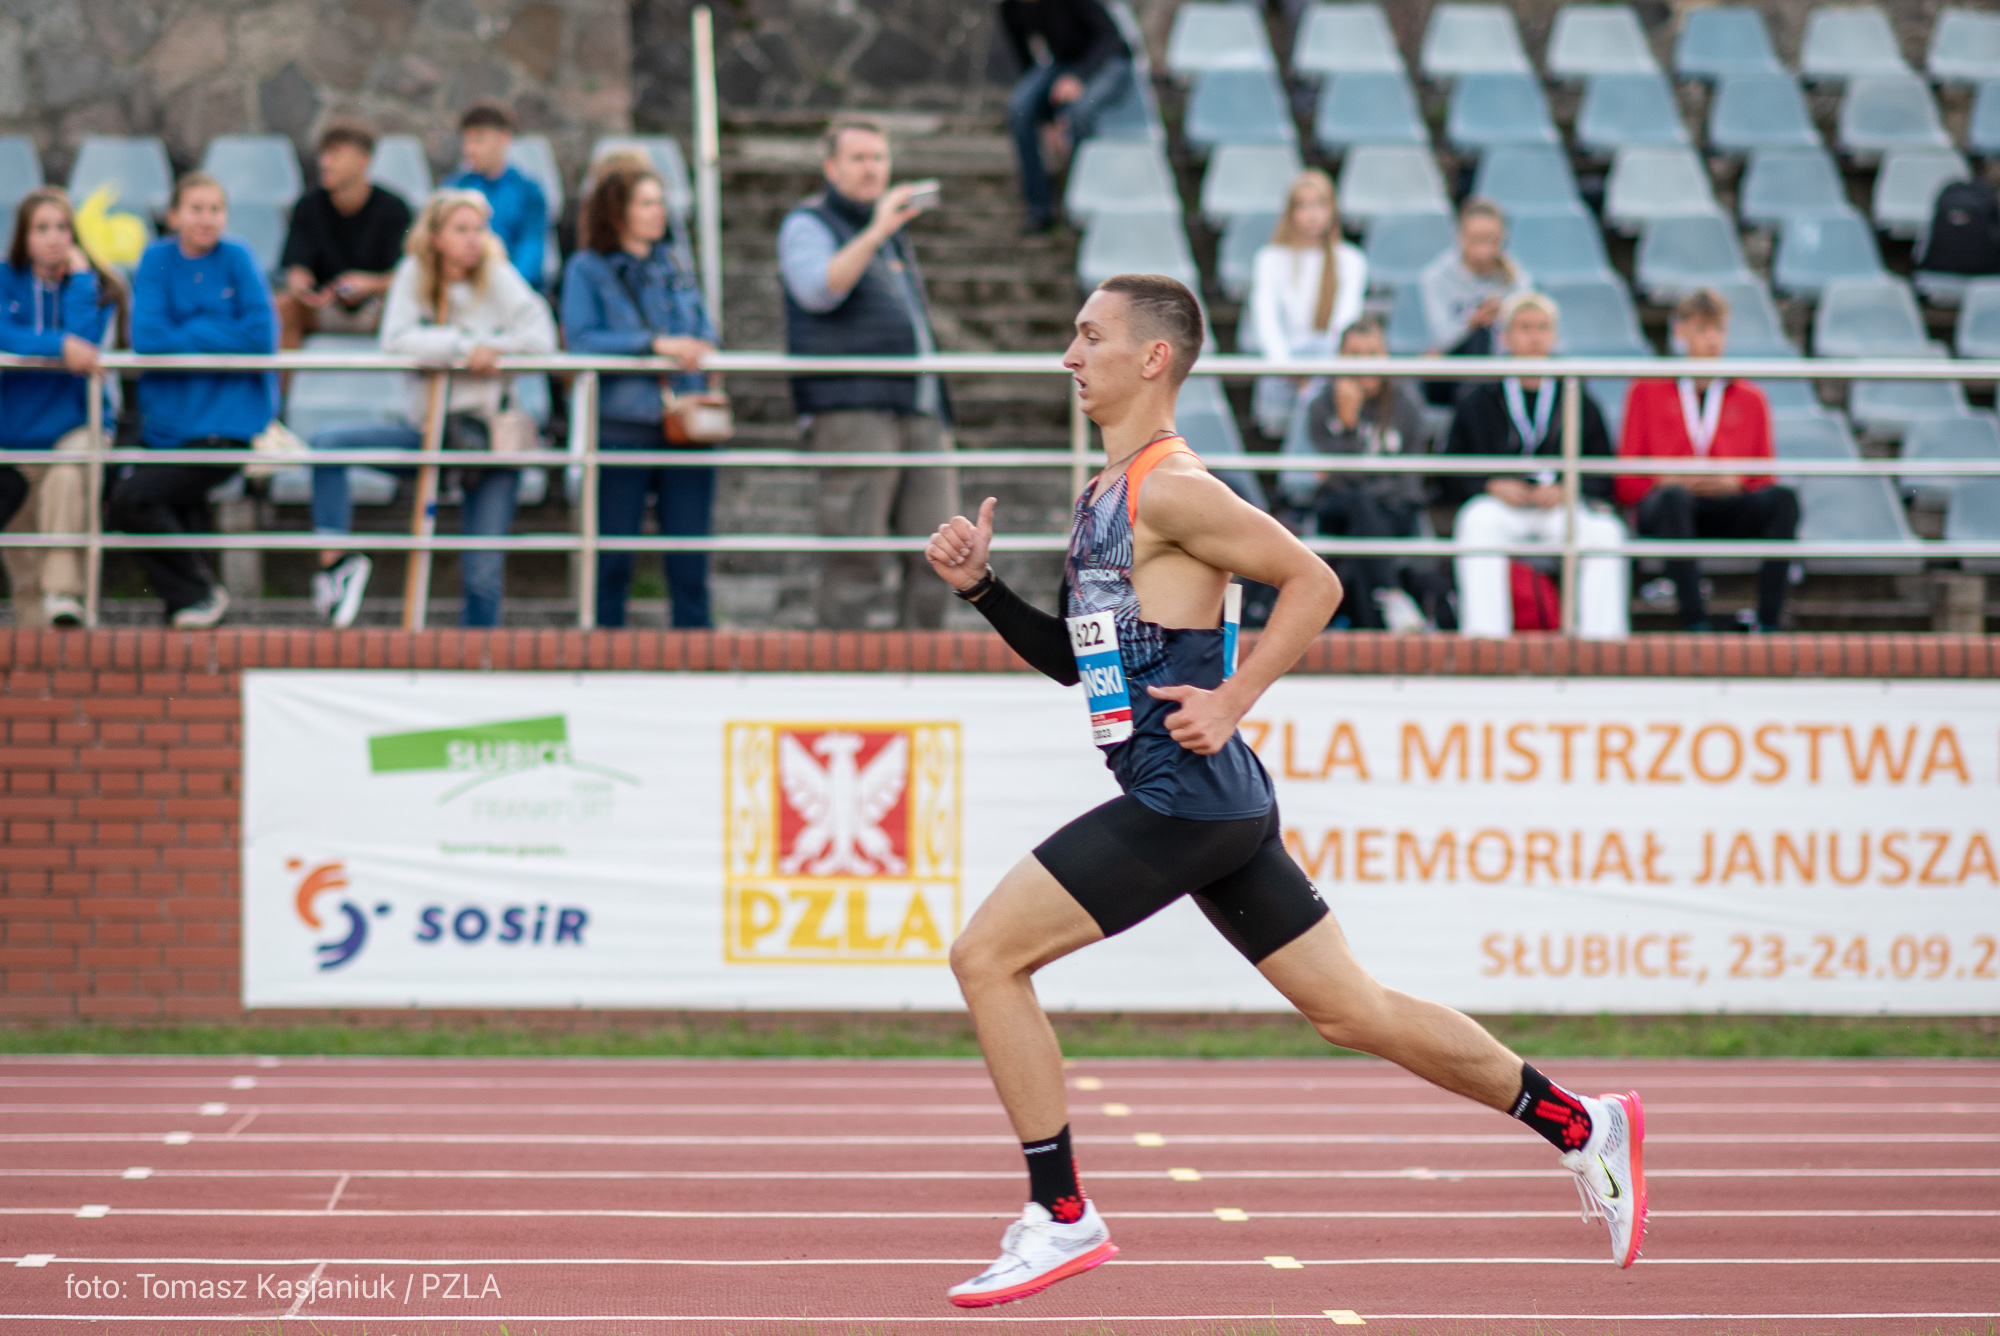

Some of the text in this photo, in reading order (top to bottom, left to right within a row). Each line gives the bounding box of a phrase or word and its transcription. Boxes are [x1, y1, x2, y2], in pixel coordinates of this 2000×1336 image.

[1400, 721, 1970, 785] MISTRZOSTWA
[1283, 828, 2000, 886] MEMORIAŁ JANUSZA
[739, 888, 944, 950] PZLA
[1481, 933, 1707, 984] SŁUBICE,
